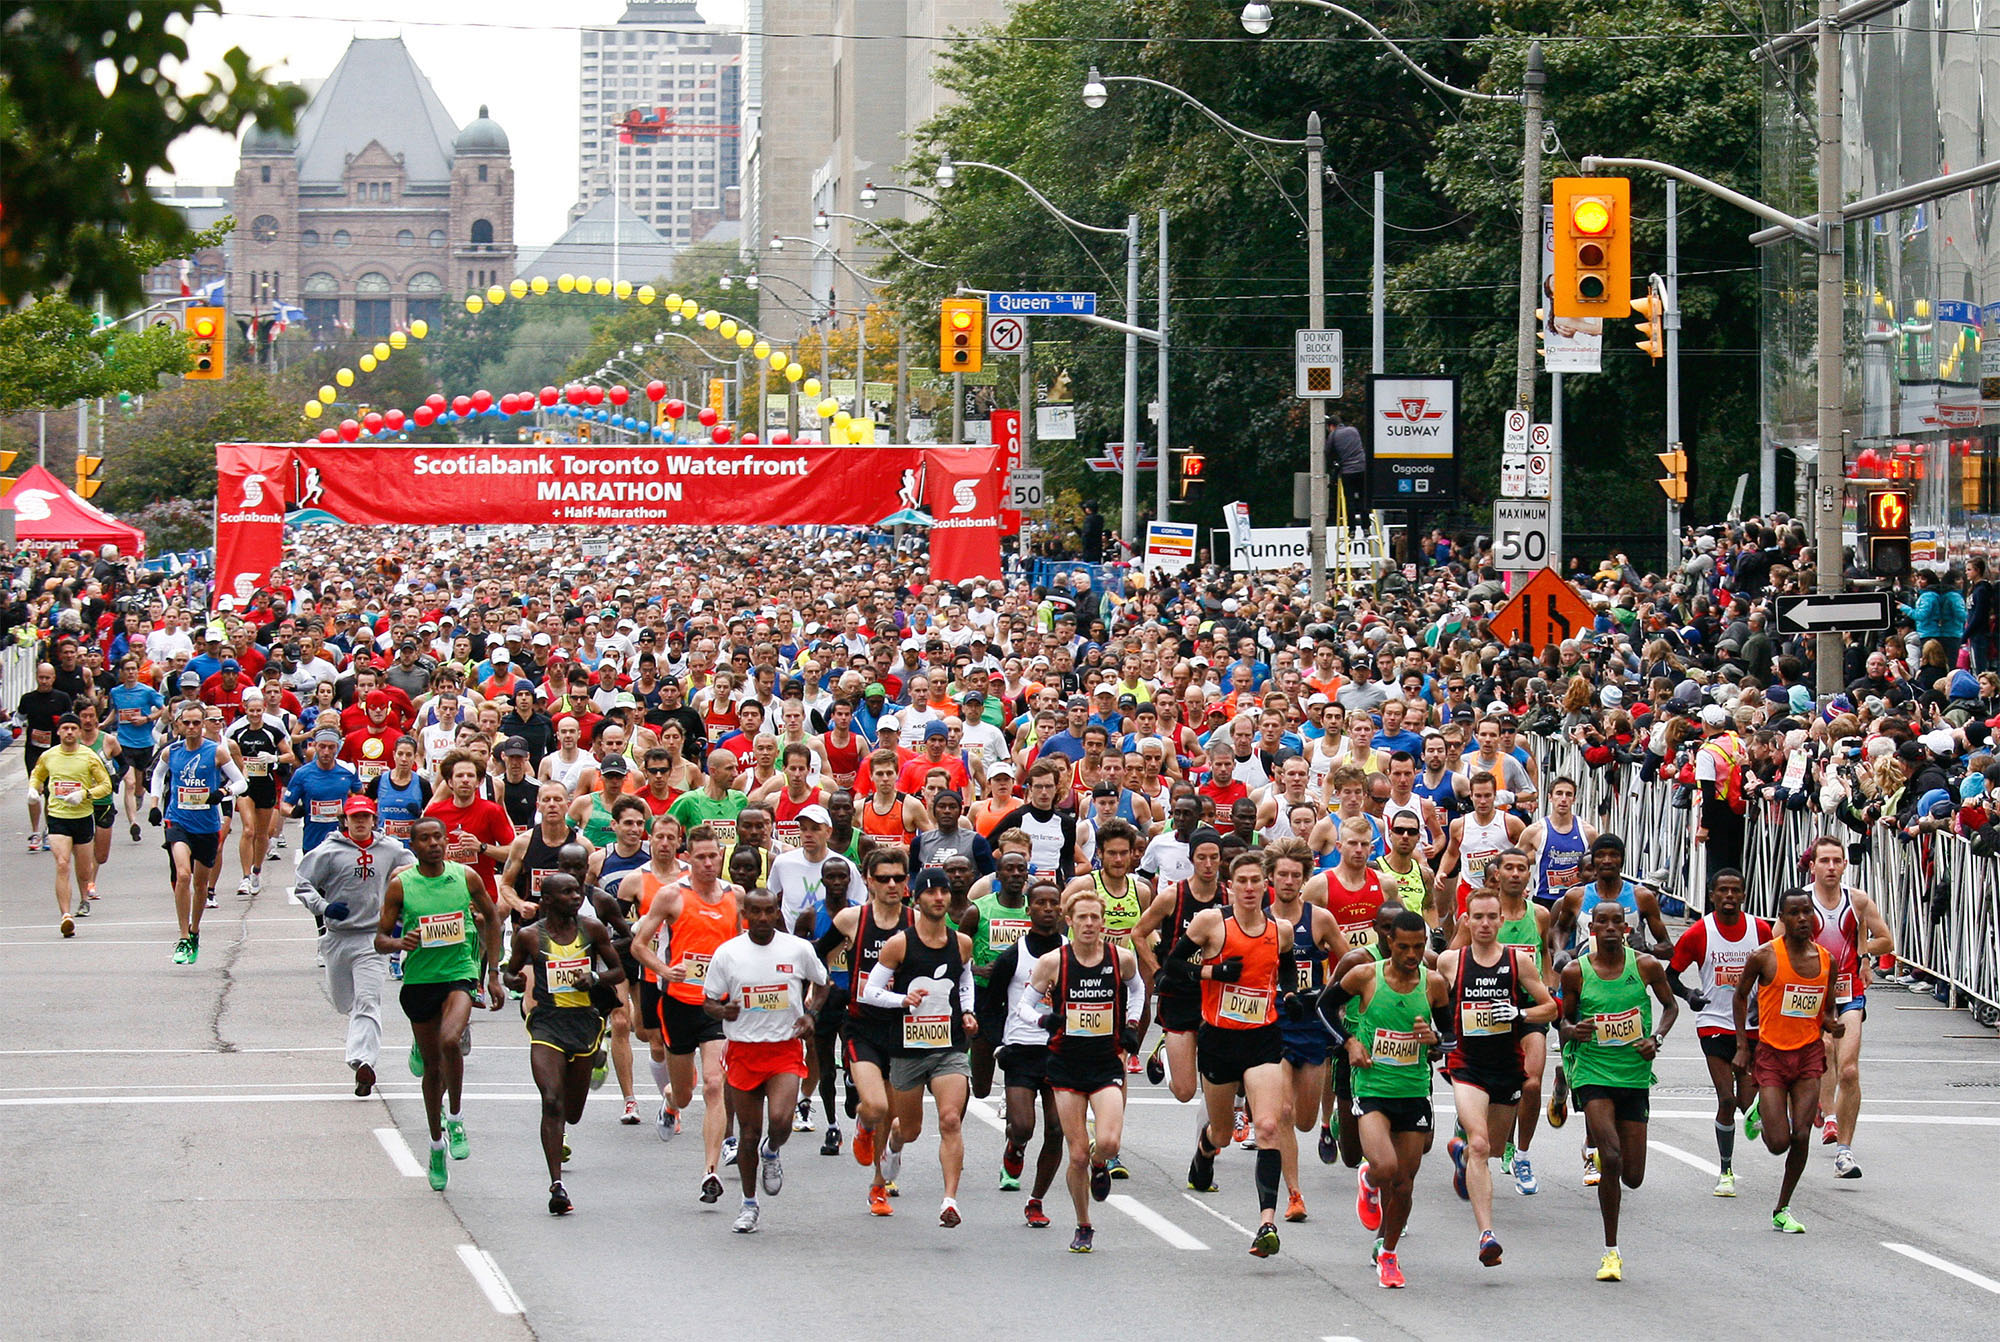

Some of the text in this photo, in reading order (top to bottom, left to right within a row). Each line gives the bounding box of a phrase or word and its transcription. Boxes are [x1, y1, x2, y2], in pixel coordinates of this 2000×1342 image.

[1000, 295, 1085, 311] Queen St W
[1303, 333, 1334, 343] DO NOT
[1306, 343, 1332, 353] BLOCK
[1300, 355, 1339, 364] INTERSECTION
[1387, 426, 1440, 437] SUBWAY
[413, 454, 808, 476] Scotiabank Toronto Waterfront
[1392, 464, 1435, 475] Osgoode
[537, 482, 683, 502] MARATHON
[1015, 486, 1041, 505] 50
[565, 506, 667, 519] Half-Marathon
[1498, 509, 1547, 521] MAXIMUM
[931, 517, 997, 531] Scotiabank
[1501, 531, 1546, 562] 50
[433, 739, 449, 749] 100
[184, 778, 207, 787] VFAC
[1104, 910, 1138, 918] ROOKS
[426, 921, 461, 940] MWANGI
[1349, 931, 1368, 947] 40
[1080, 978, 1102, 987] new
[1475, 978, 1498, 986] new
[758, 993, 780, 1004] MARK
[1069, 988, 1114, 999] balance
[1465, 987, 1509, 998] balance
[1230, 996, 1260, 1015] DYLAN
[1791, 994, 1818, 1011] PACER
[1080, 1013, 1101, 1028] ERIC
[906, 1025, 950, 1041] BRANDON
[1604, 1019, 1635, 1039] PACER
